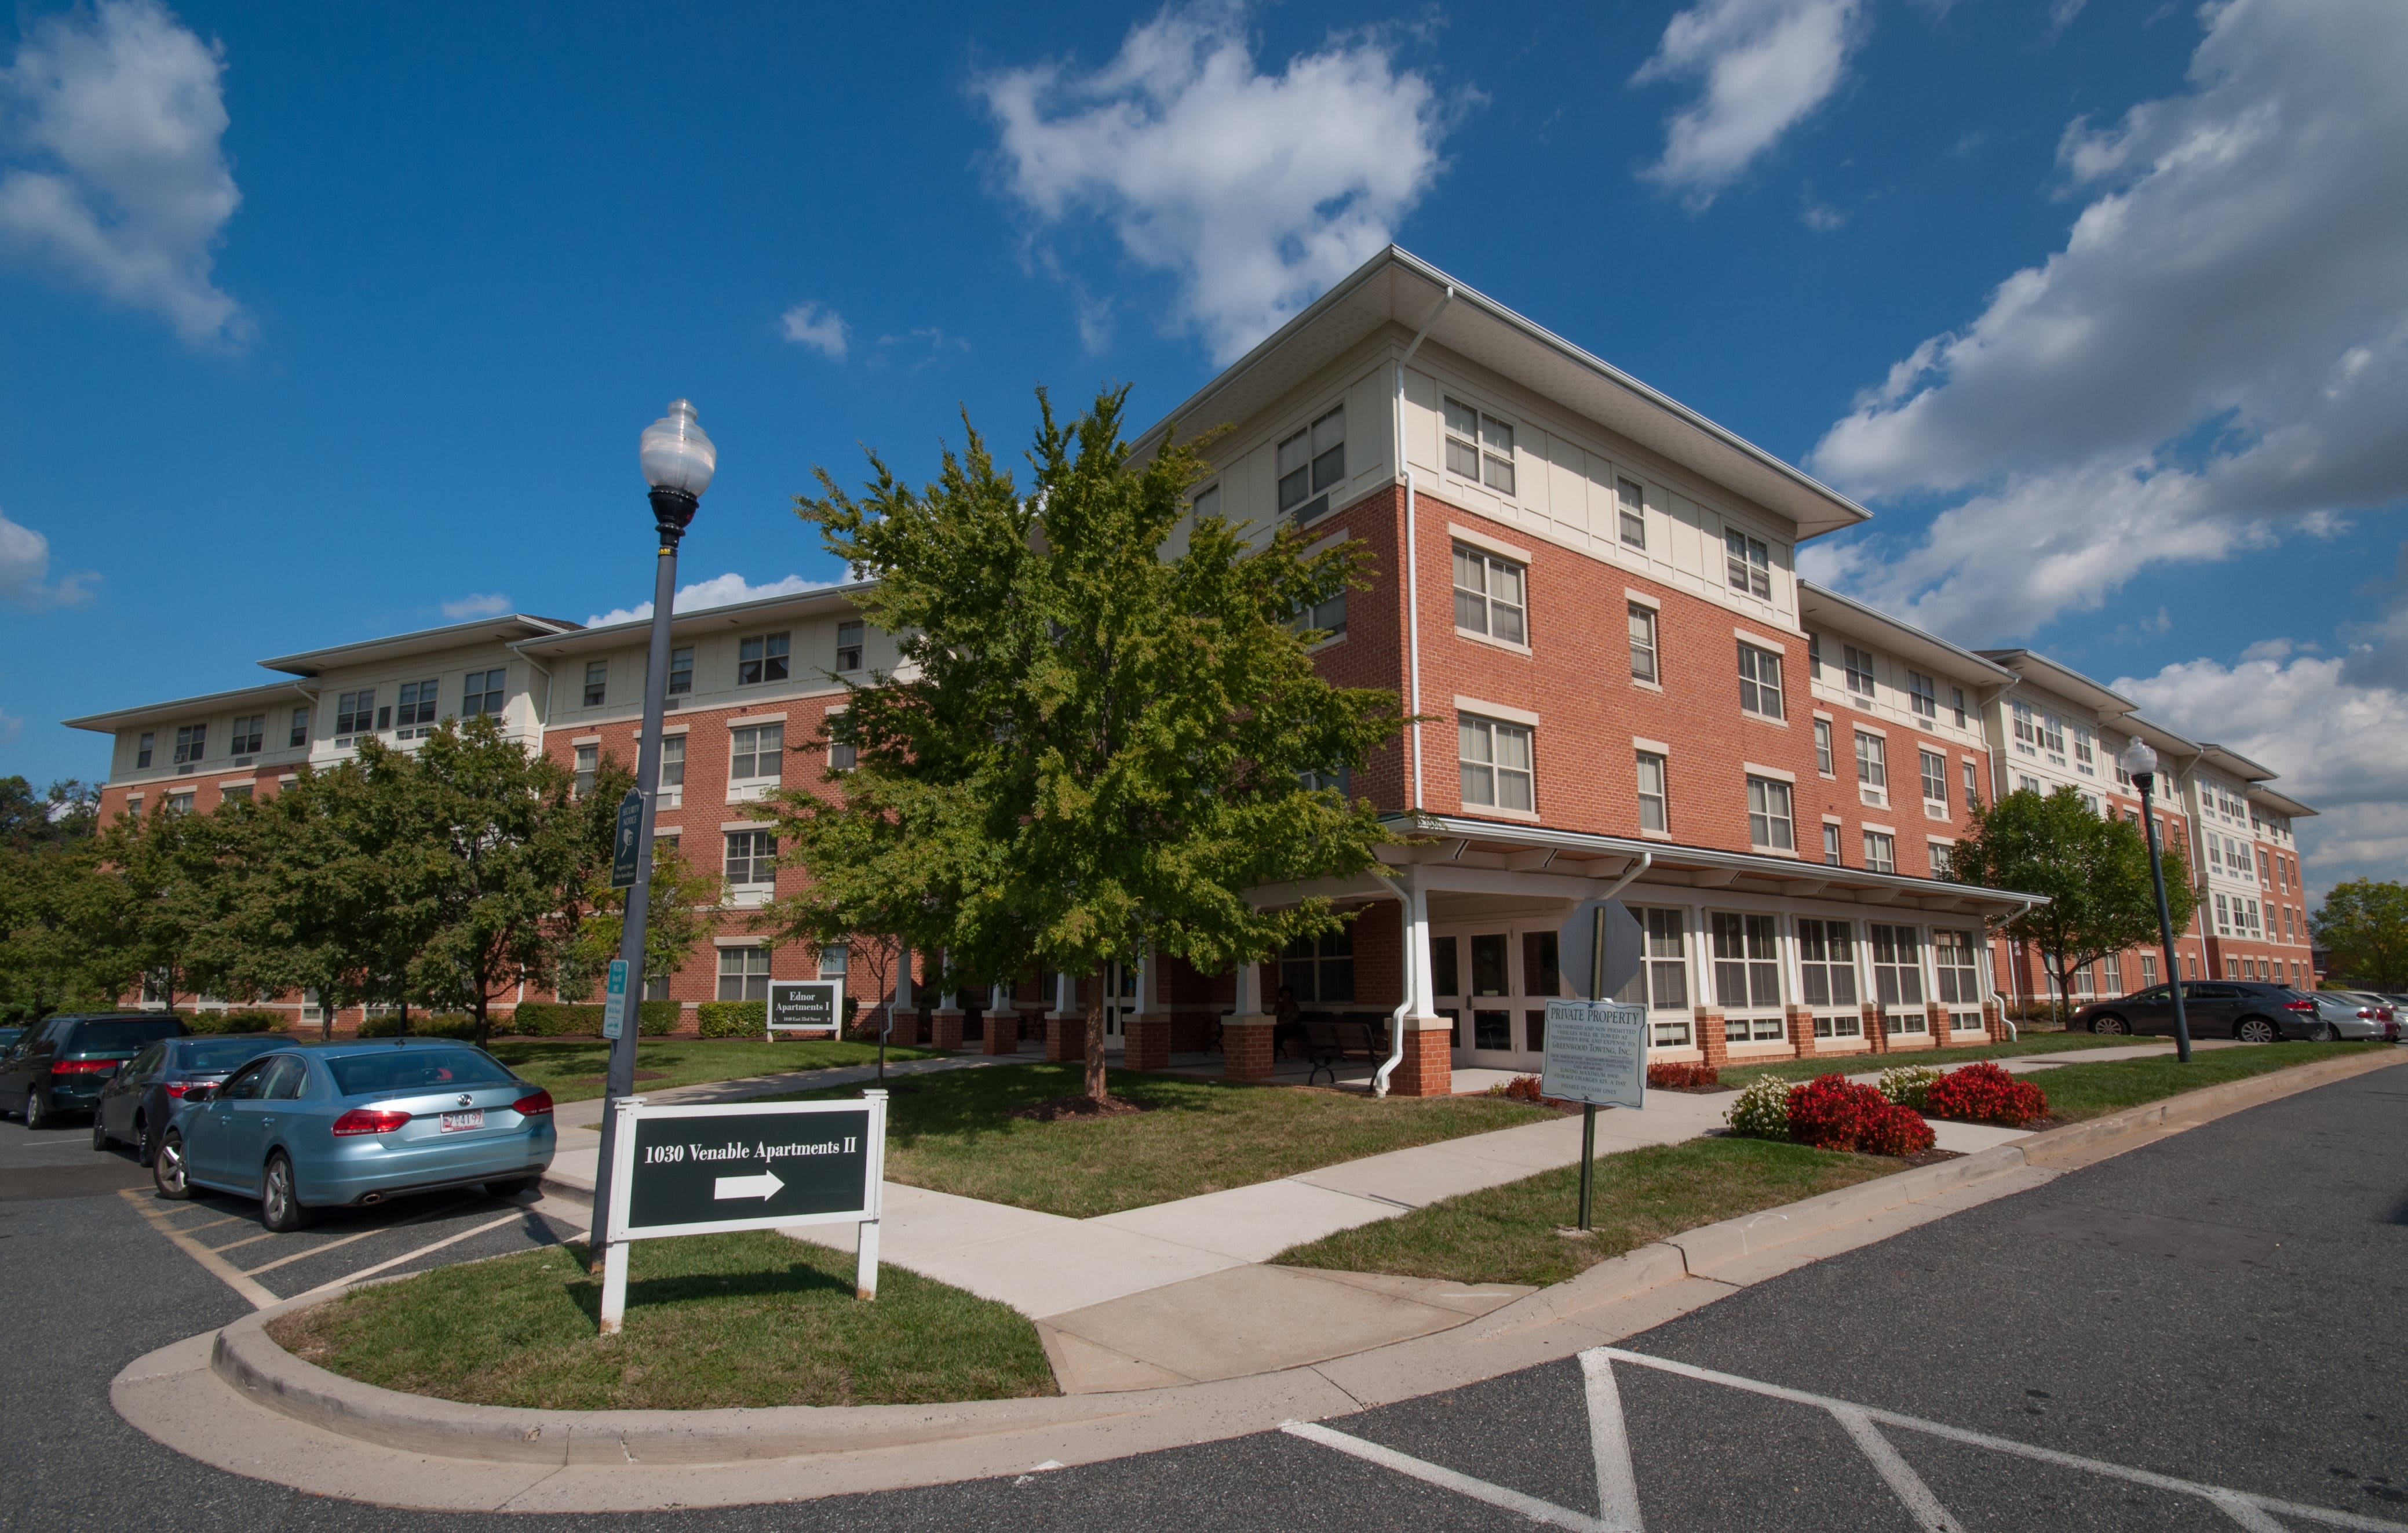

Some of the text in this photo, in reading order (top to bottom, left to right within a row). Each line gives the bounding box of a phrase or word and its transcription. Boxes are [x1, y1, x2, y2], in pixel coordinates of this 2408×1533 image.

[623, 804, 640, 816] SECURITY
[623, 815, 637, 825] NOTICE
[790, 992, 815, 1001] Ednor
[776, 1002, 830, 1013] Apartments I
[1551, 1008, 1639, 1025] PRIVATE PROPERTY
[1552, 1041, 1632, 1055] GREENWOOD TOWING, INC.
[644, 1137, 857, 1163] 1030 Venable Apartments II
